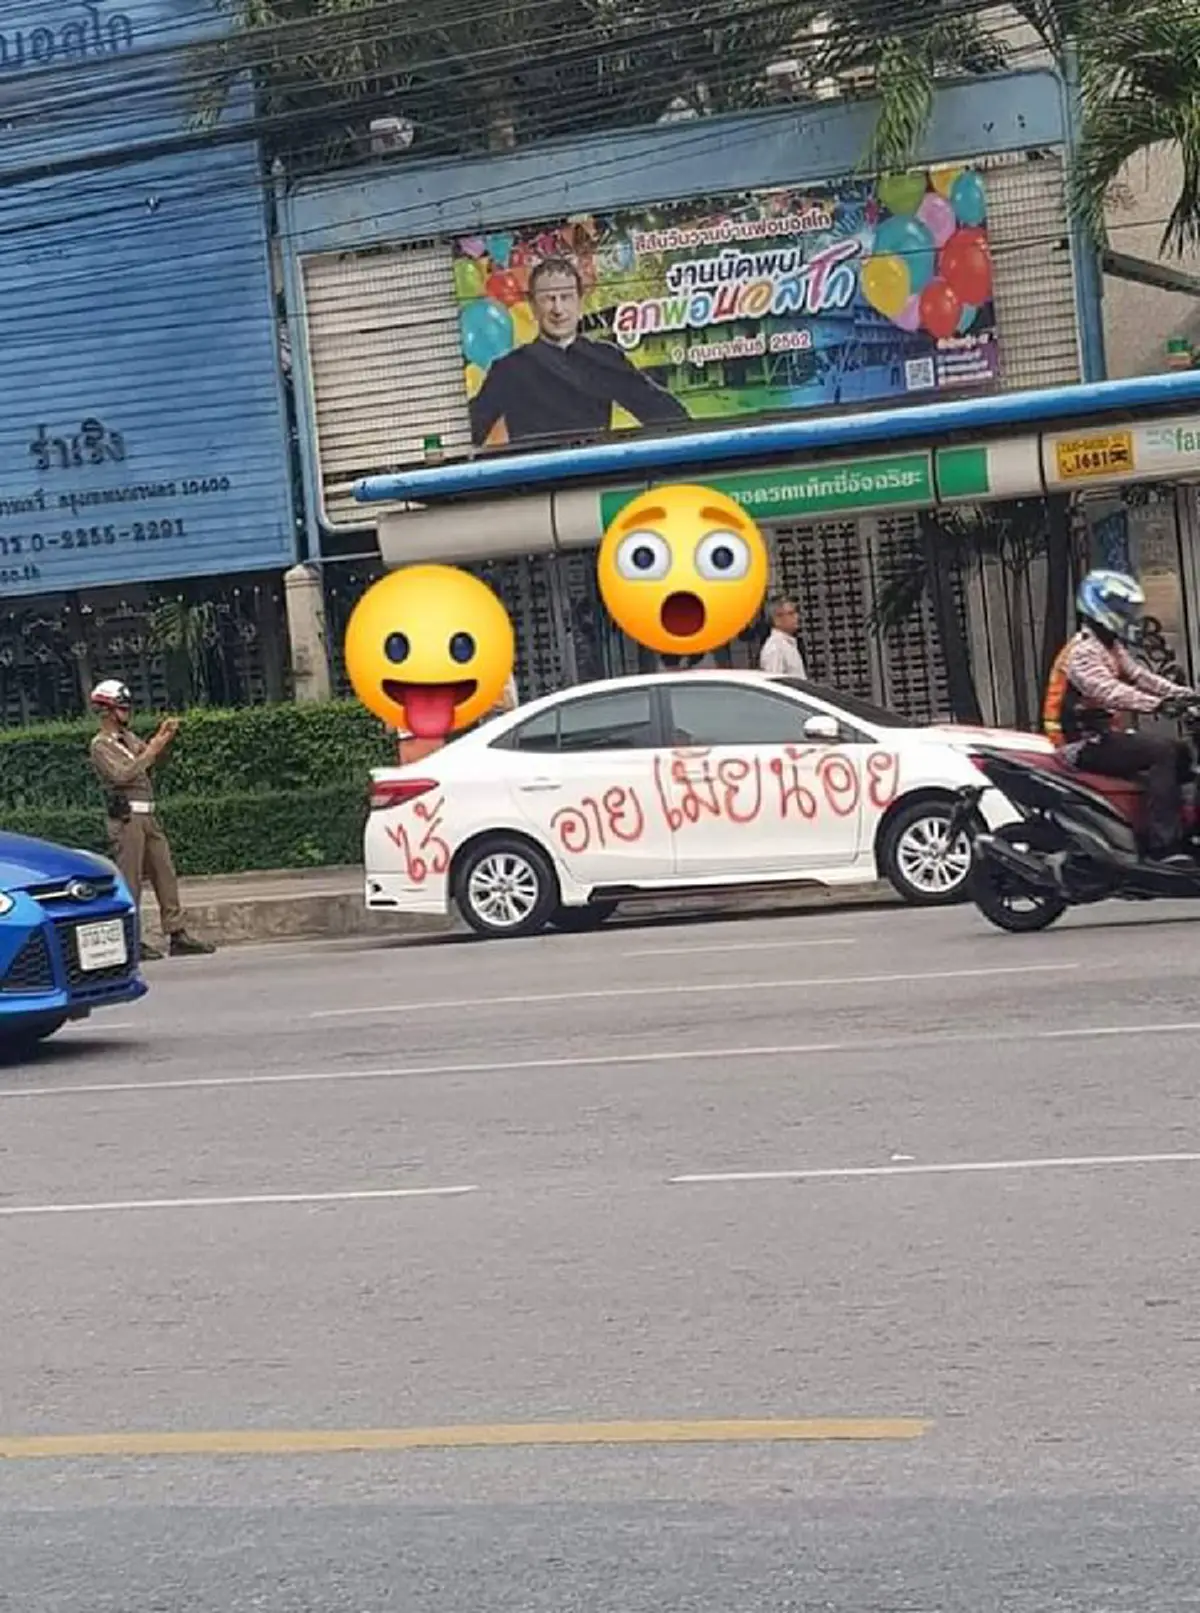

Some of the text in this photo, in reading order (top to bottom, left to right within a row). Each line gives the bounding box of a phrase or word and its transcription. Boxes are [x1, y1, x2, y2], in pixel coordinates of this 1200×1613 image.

[616, 240, 862, 346] ลูกพ่อบอสโก
[689, 335, 765, 366] กุมภาพันธ์
[770, 332, 811, 351] 2562
[29, 417, 125, 470] ร่าเริง
